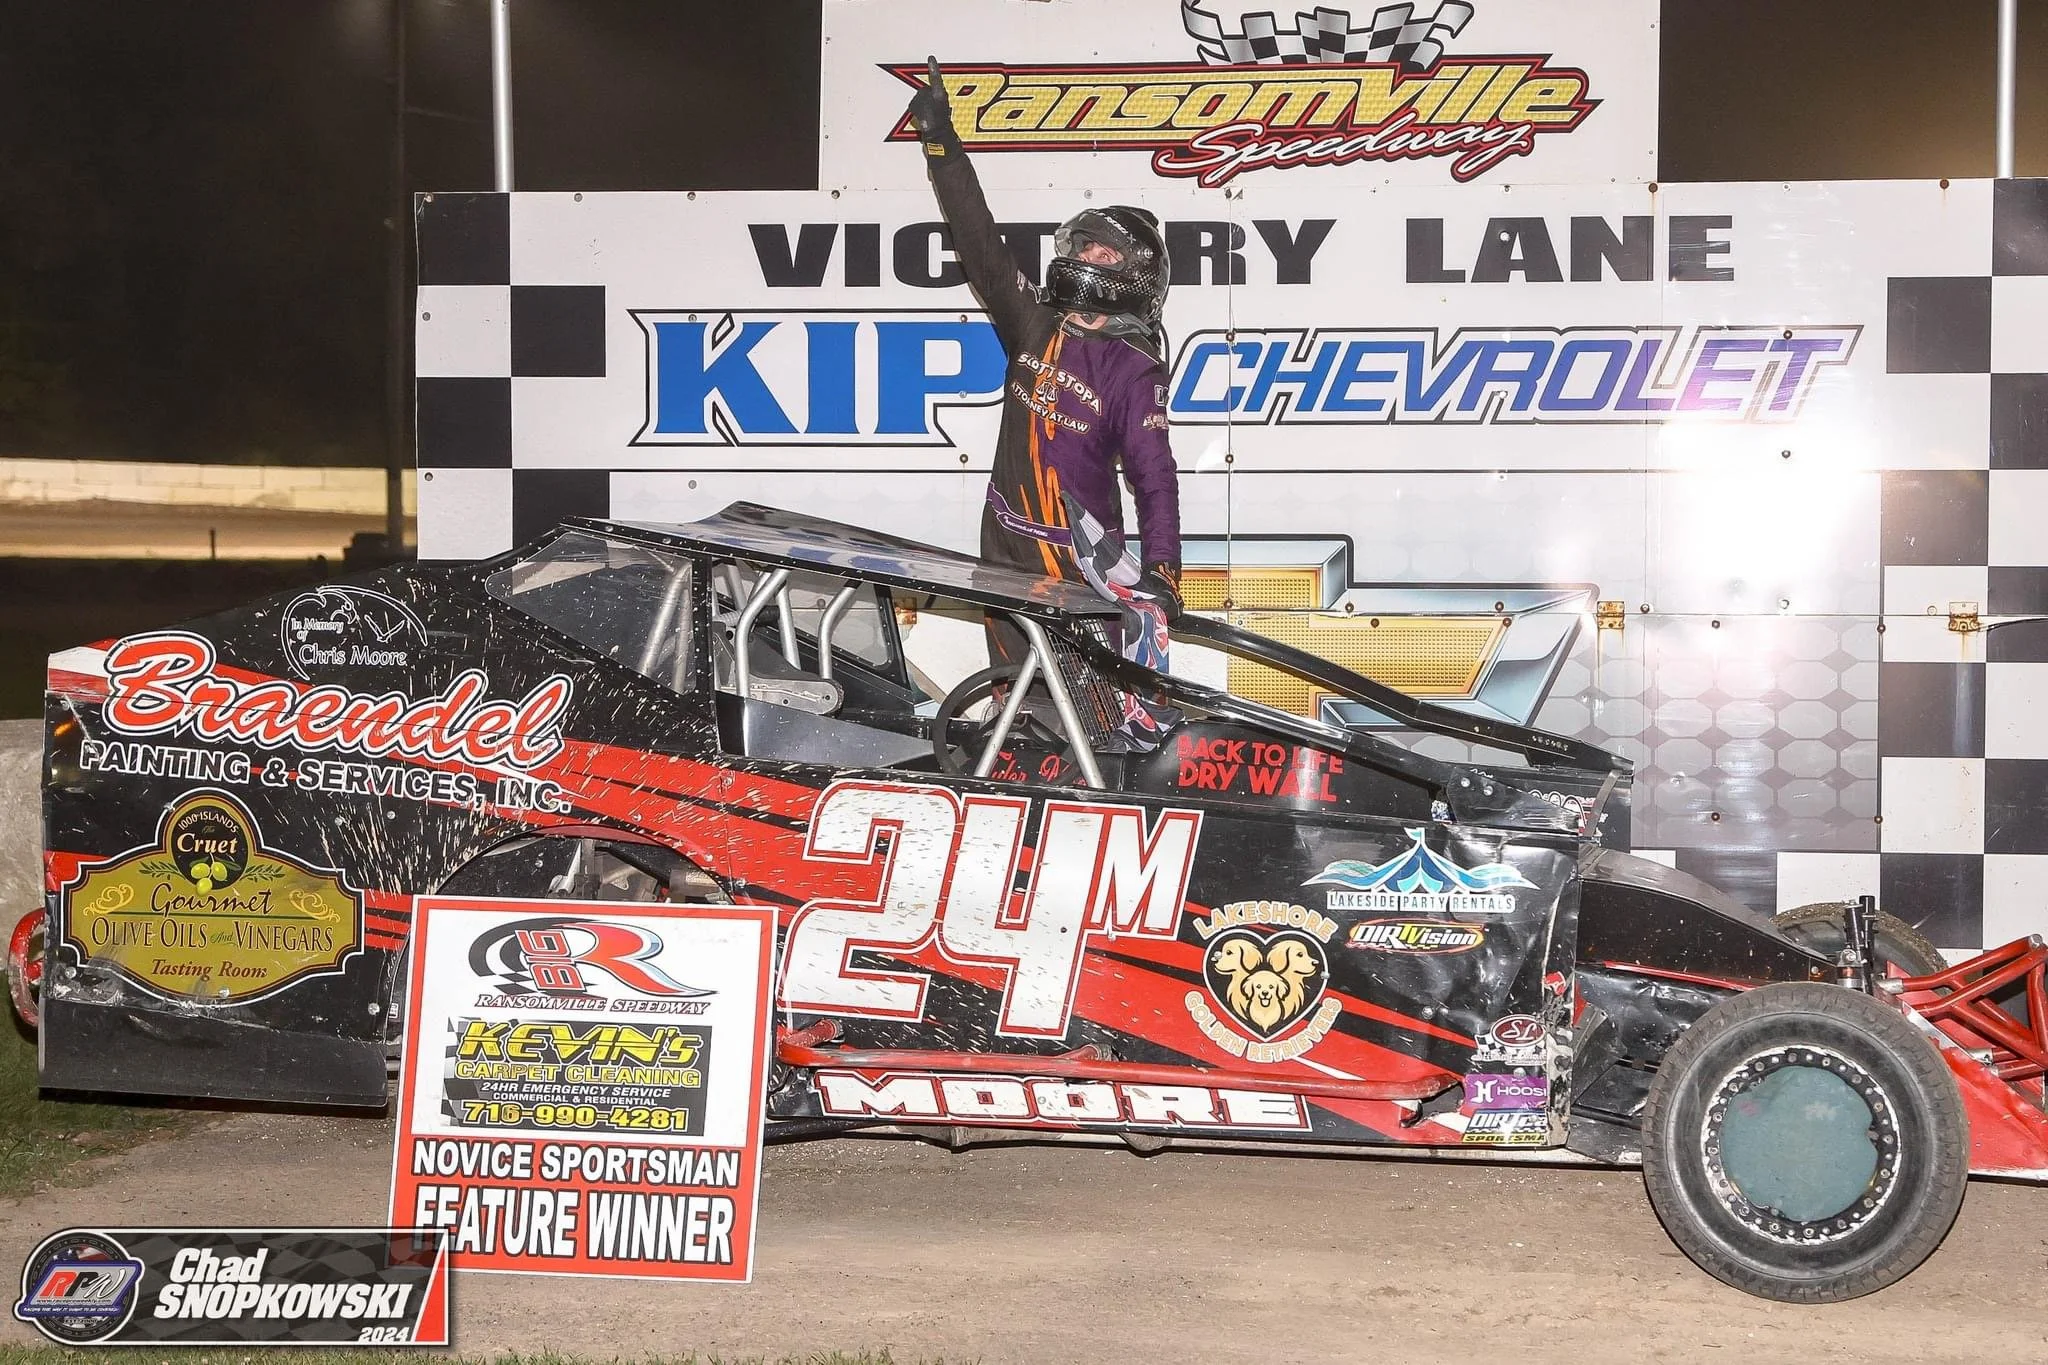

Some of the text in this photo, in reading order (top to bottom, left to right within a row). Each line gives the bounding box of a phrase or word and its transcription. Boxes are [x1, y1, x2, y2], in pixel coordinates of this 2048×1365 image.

[1157, 112, 1532, 184] Speedway
[748, 215, 1735, 288] VICTRY LANE
[1017, 353, 1101, 414] SCOTT STOPA
[1170, 337, 1846, 413] CHEVROLET
[1049, 412, 1063, 423] AT
[1063, 417, 1088, 432] LAW
[297, 630, 308, 642] of
[303, 617, 344, 634] Memory
[299, 643, 407, 666] Chris Moore
[101, 631, 573, 767] Braendel
[1176, 735, 1248, 764] BACK
[1252, 742, 1286, 767] TO
[80, 741, 573, 814] PAINTING & SERVICES, INC.
[1178, 760, 1337, 802] DRY WALL
[178, 811, 240, 834] 1000 ISLANDS
[177, 833, 238, 854] Cruet
[150, 882, 275, 917] Gourmet
[1330, 893, 1513, 910] LAKESIDE PARTY RENTALS
[91, 916, 153, 948] OLIVE
[160, 918, 208, 949] OILS
[234, 921, 334, 952] VINEGARS
[1193, 900, 1339, 944] LAKESHORE
[151, 959, 268, 982] Tasting Room
[514, 928, 587, 992] BIG
[474, 994, 712, 1015] RANSOMVILLE SPEEDWAY
[1185, 990, 1343, 1063] GOLDEN RETRIEVERS
[456, 1061, 701, 1088] CARPET CLEANING
[481, 1082, 671, 1098] 24HR EMERGENCY SERVICE
[461, 1099, 689, 1132] 716-990-4281
[492, 1092, 658, 1106] COMMERCIAL & RESIDENTIAL
[813, 1069, 1313, 1132] MOORE
[413, 1139, 741, 1188] NOVICE SPORTSMAN
[414, 1184, 736, 1265] FEATURE WINNER
